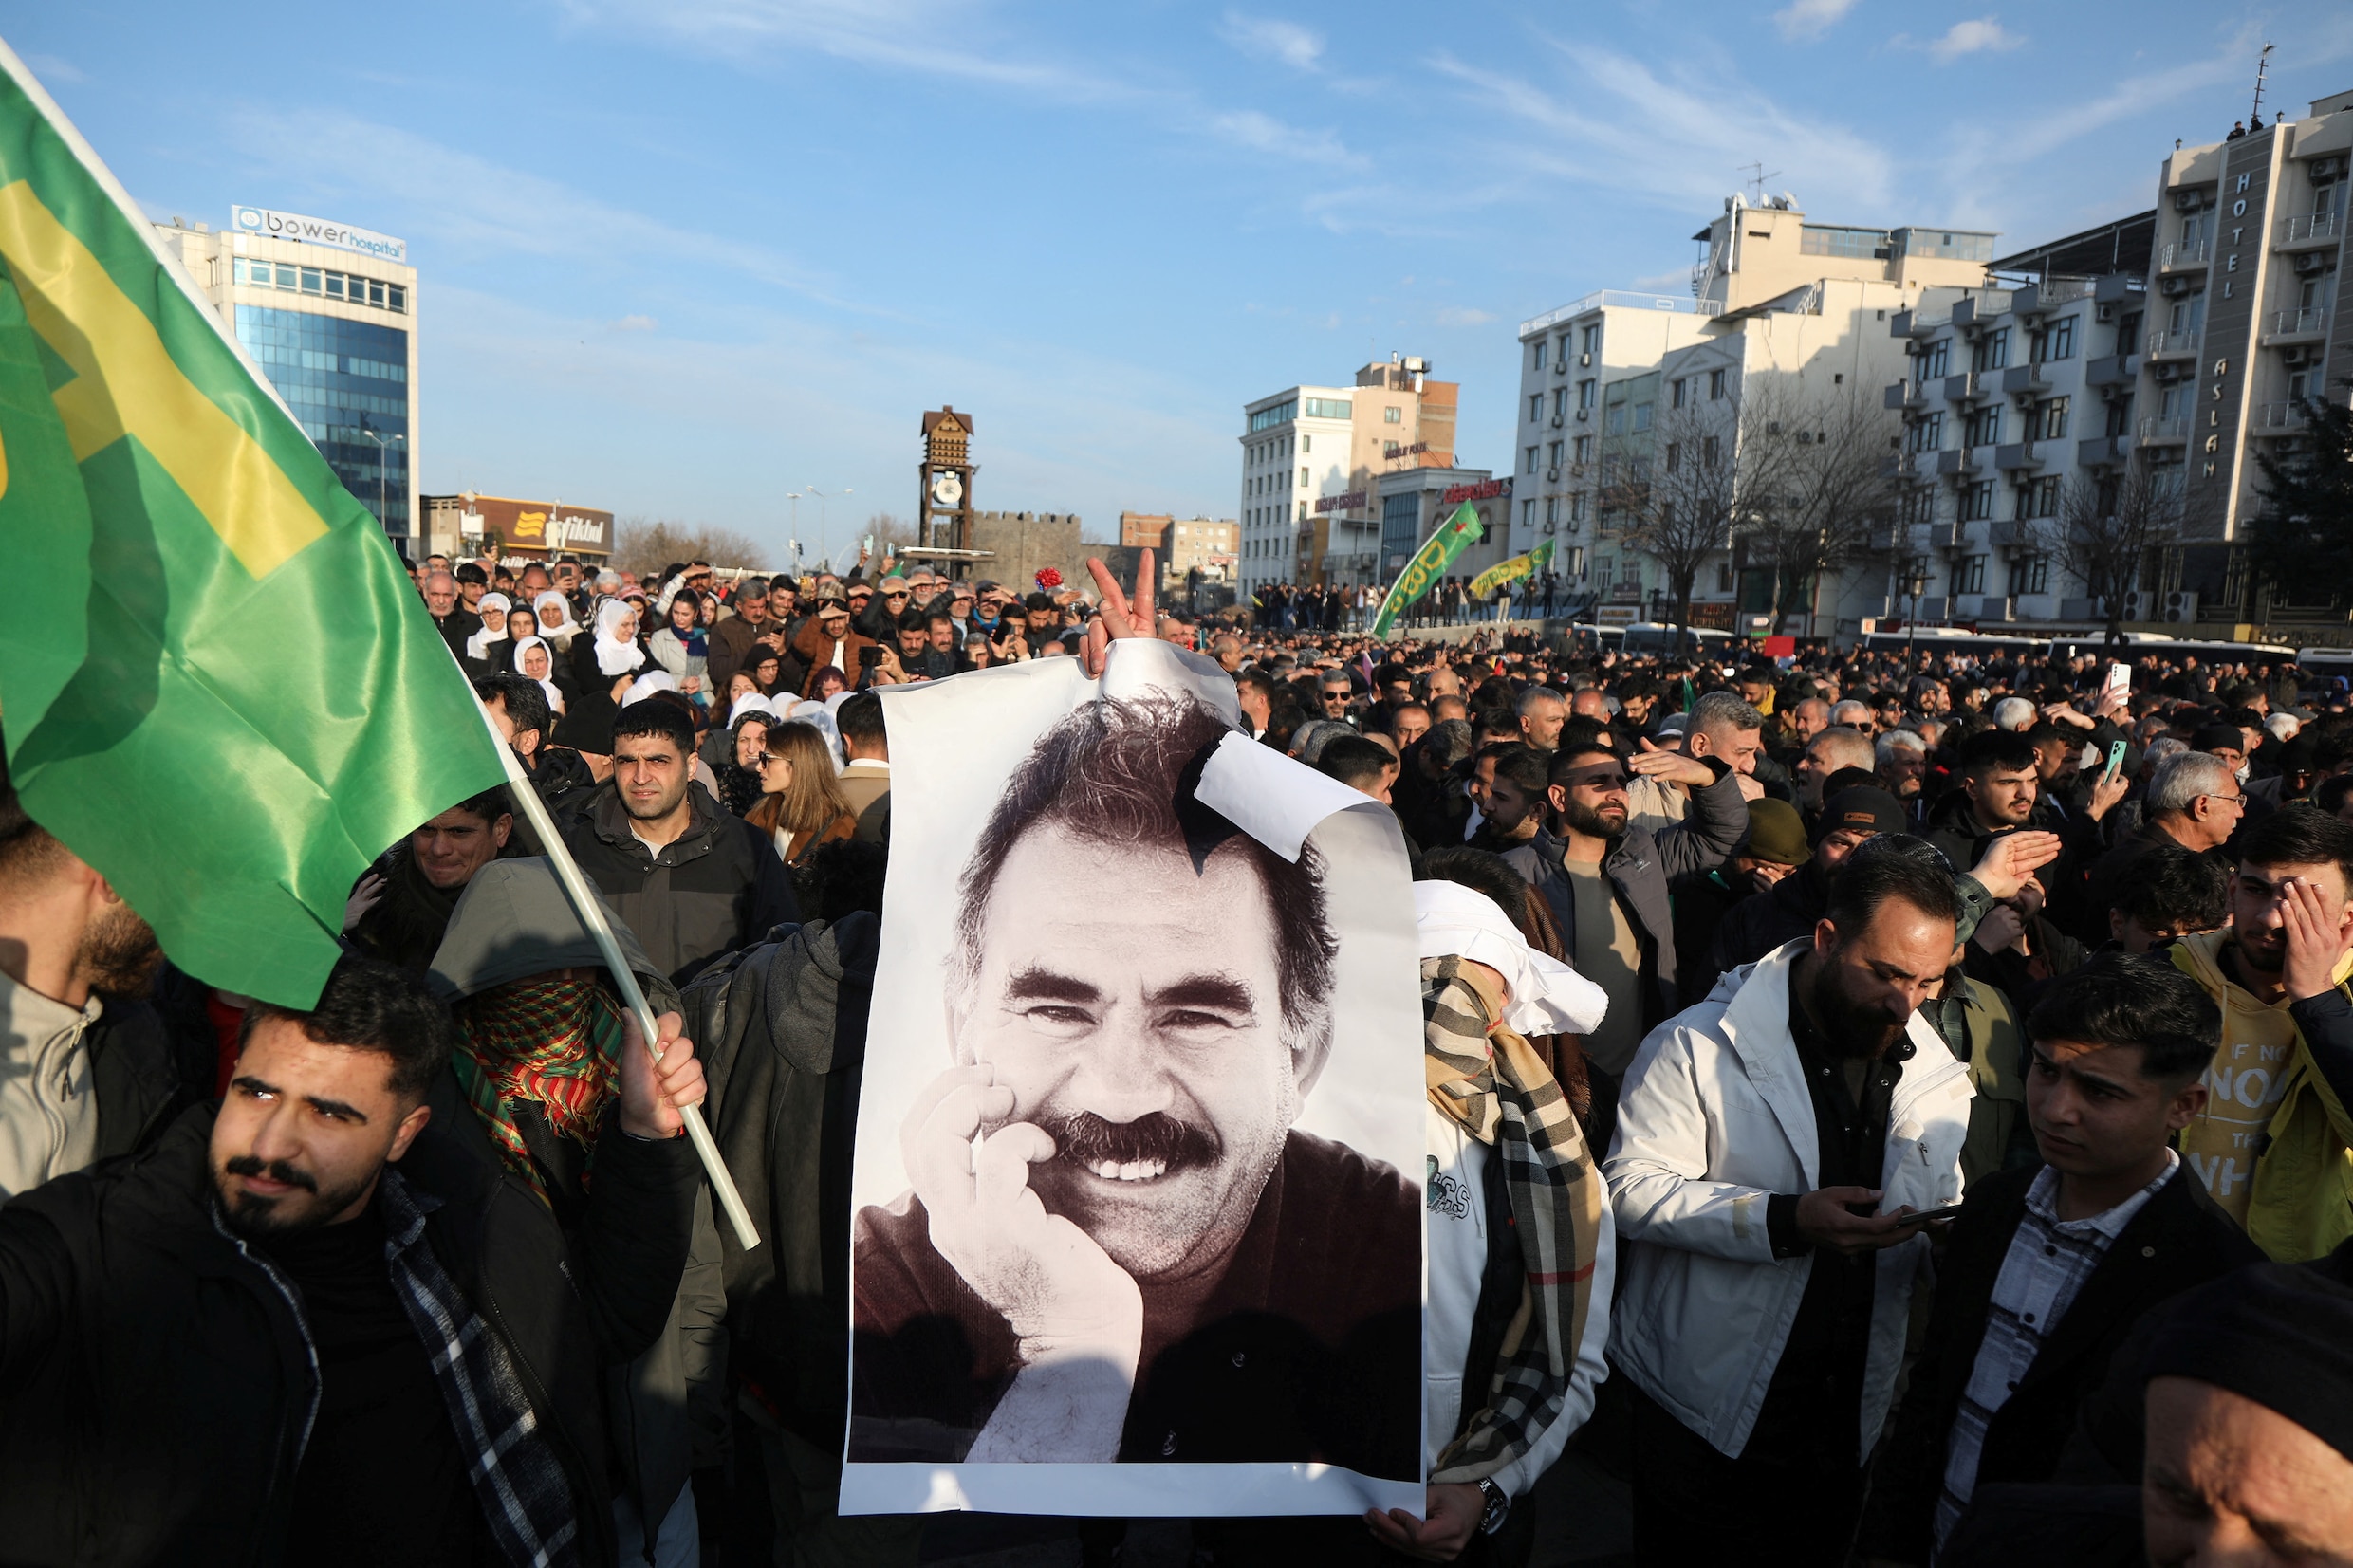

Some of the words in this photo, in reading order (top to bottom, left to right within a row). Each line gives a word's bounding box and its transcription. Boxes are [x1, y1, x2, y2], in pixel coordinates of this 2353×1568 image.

[267, 212, 347, 243] bower
[349, 232, 400, 258] hospital
[2224, 173, 2251, 299] HOTEL
[2202, 358, 2228, 478] ASLAN
[2232, 1042, 2250, 1060] IF
[2259, 1045, 2287, 1062] NO
